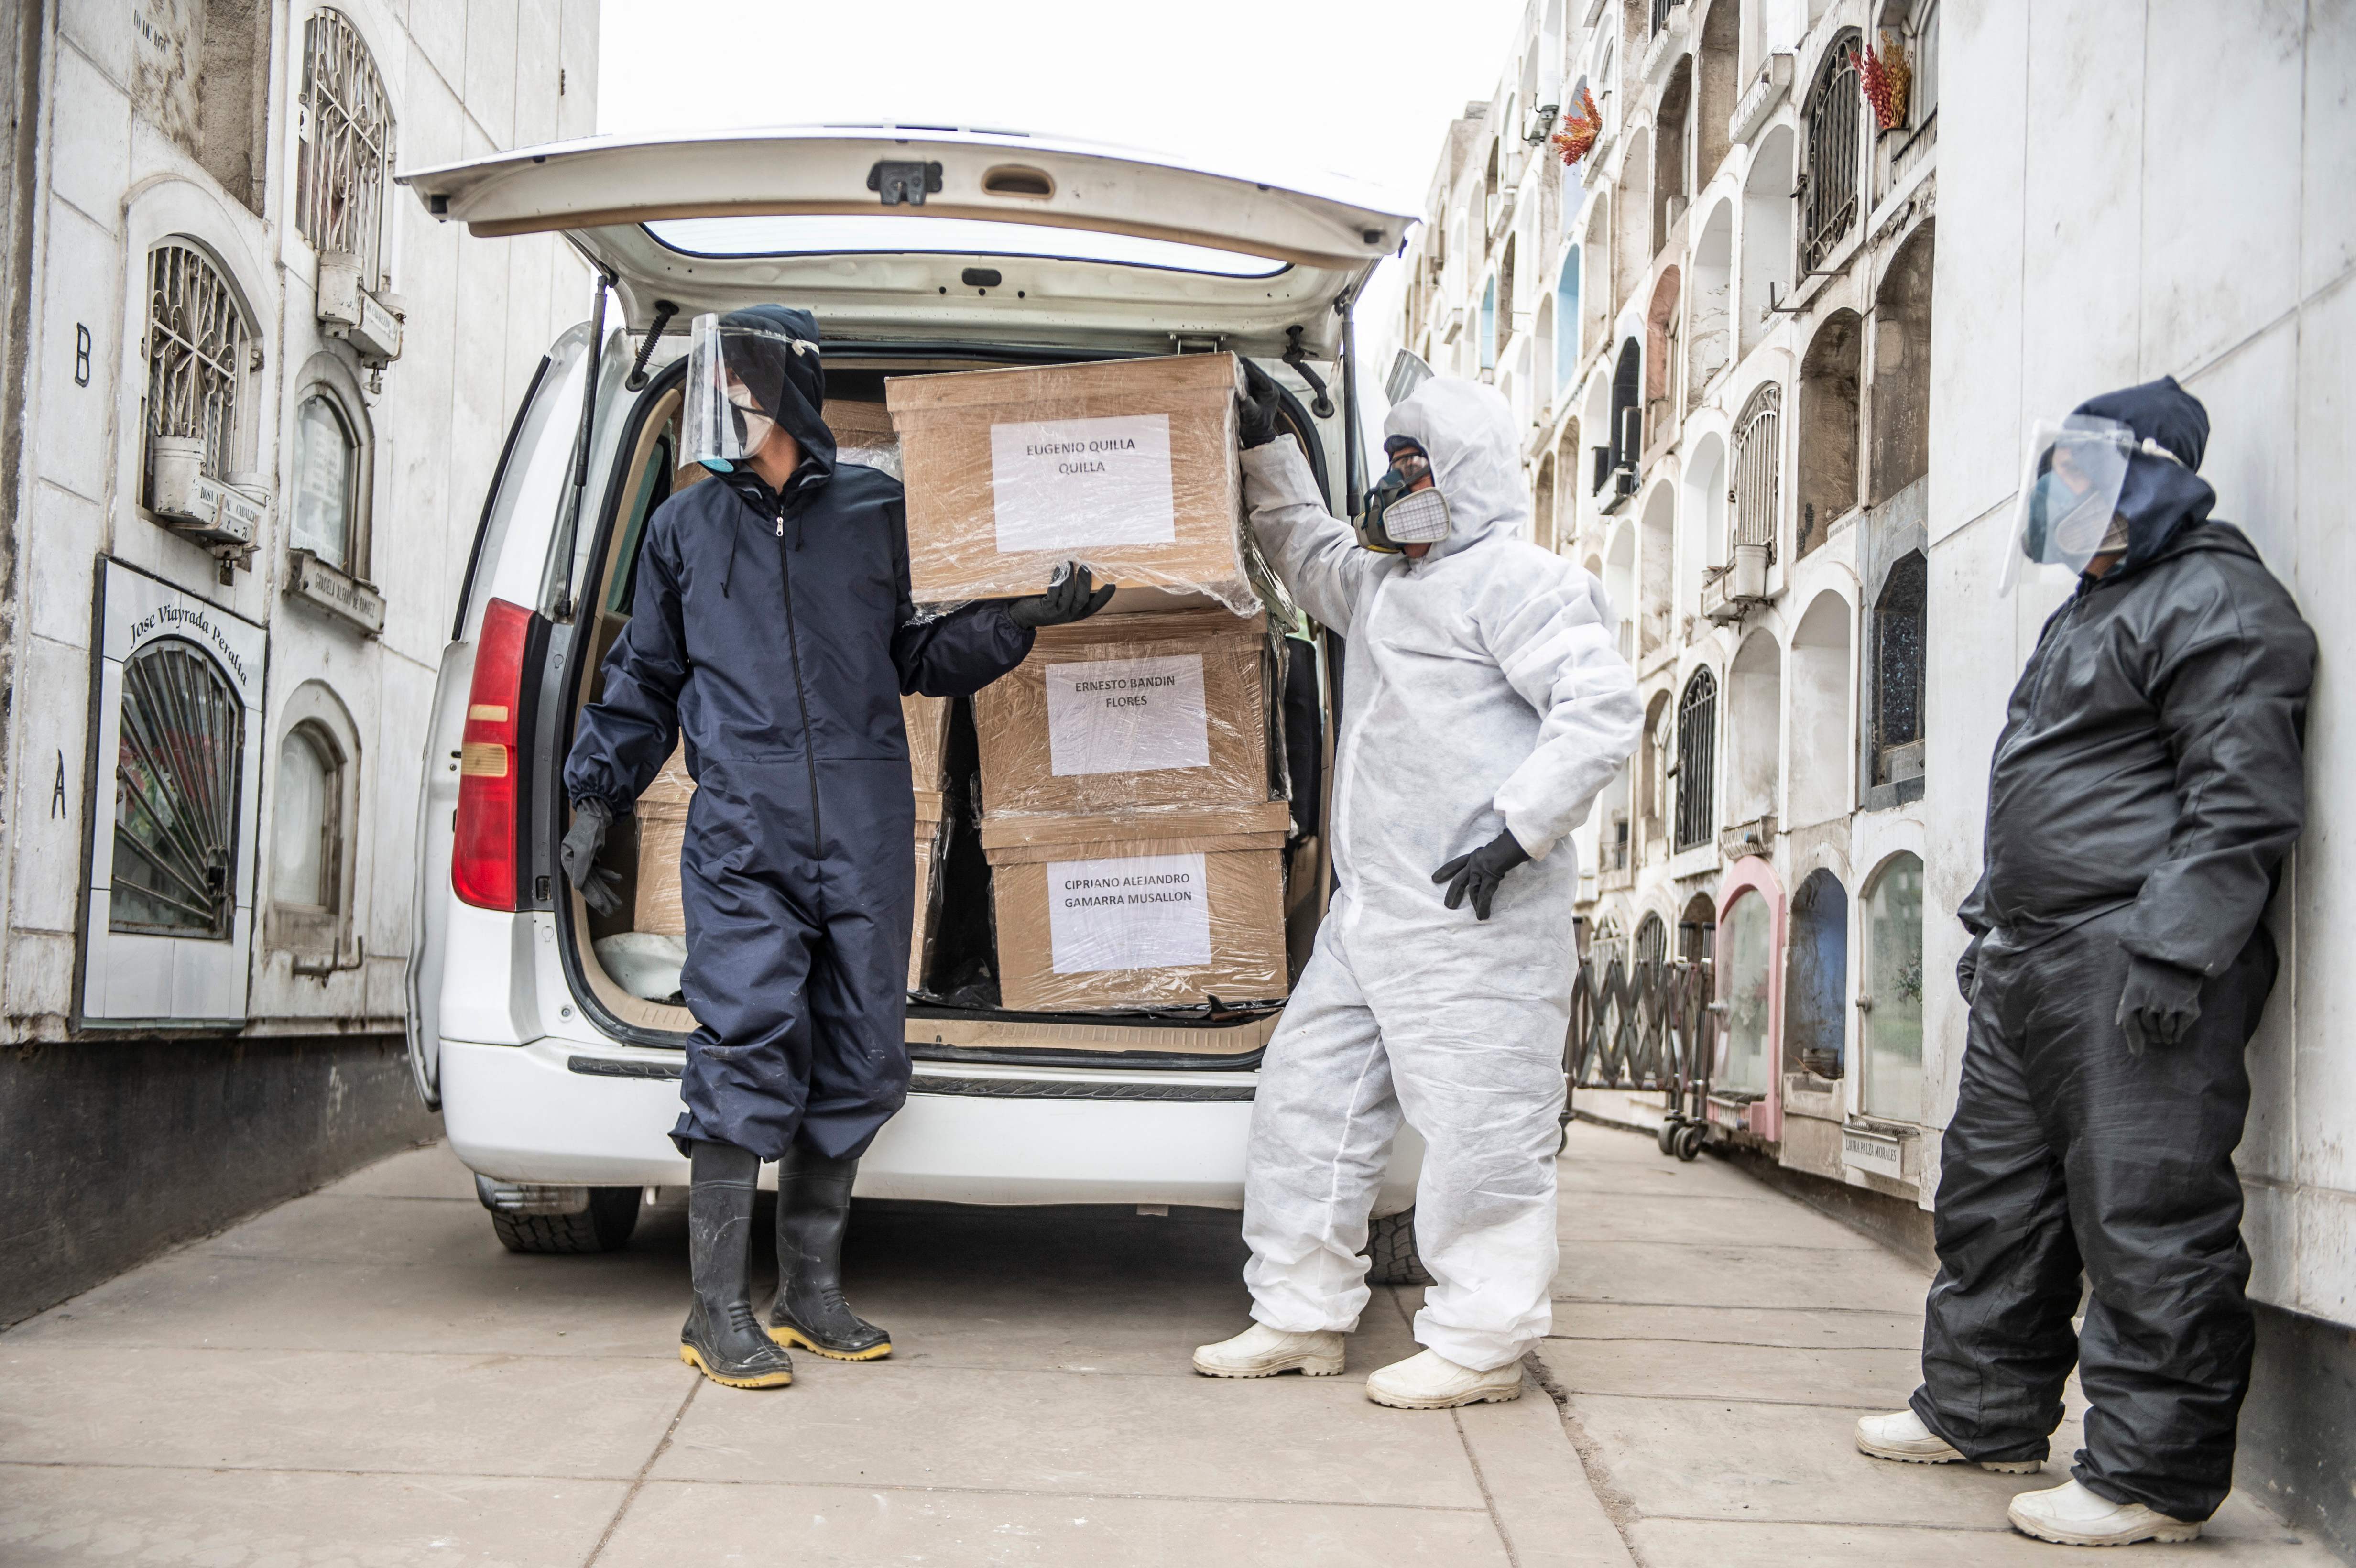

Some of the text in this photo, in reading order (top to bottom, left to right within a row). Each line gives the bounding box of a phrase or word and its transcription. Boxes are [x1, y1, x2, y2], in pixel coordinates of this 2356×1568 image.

[75, 322, 91, 388] B
[1027, 438, 1135, 456] EUGENIO QUILLA
[1059, 461, 1105, 475] QUILLA
[315, 573, 335, 596] GRACIELA
[337, 584, 352, 606] ALFARO
[359, 596, 375, 619] RAMIREZ
[130, 604, 247, 686] Jose Viayrada Peralta
[1076, 675, 1175, 692] ERNESTO BANDIN
[1106, 695, 1148, 708] FLORES
[51, 748, 66, 820] A
[1065, 873, 1190, 890] CIPRIANO ALEJANDRO
[1065, 891, 1192, 908] GAMARRA MUSALLON
[1845, 1138, 1897, 1163] LAURA PALZA MORALES
